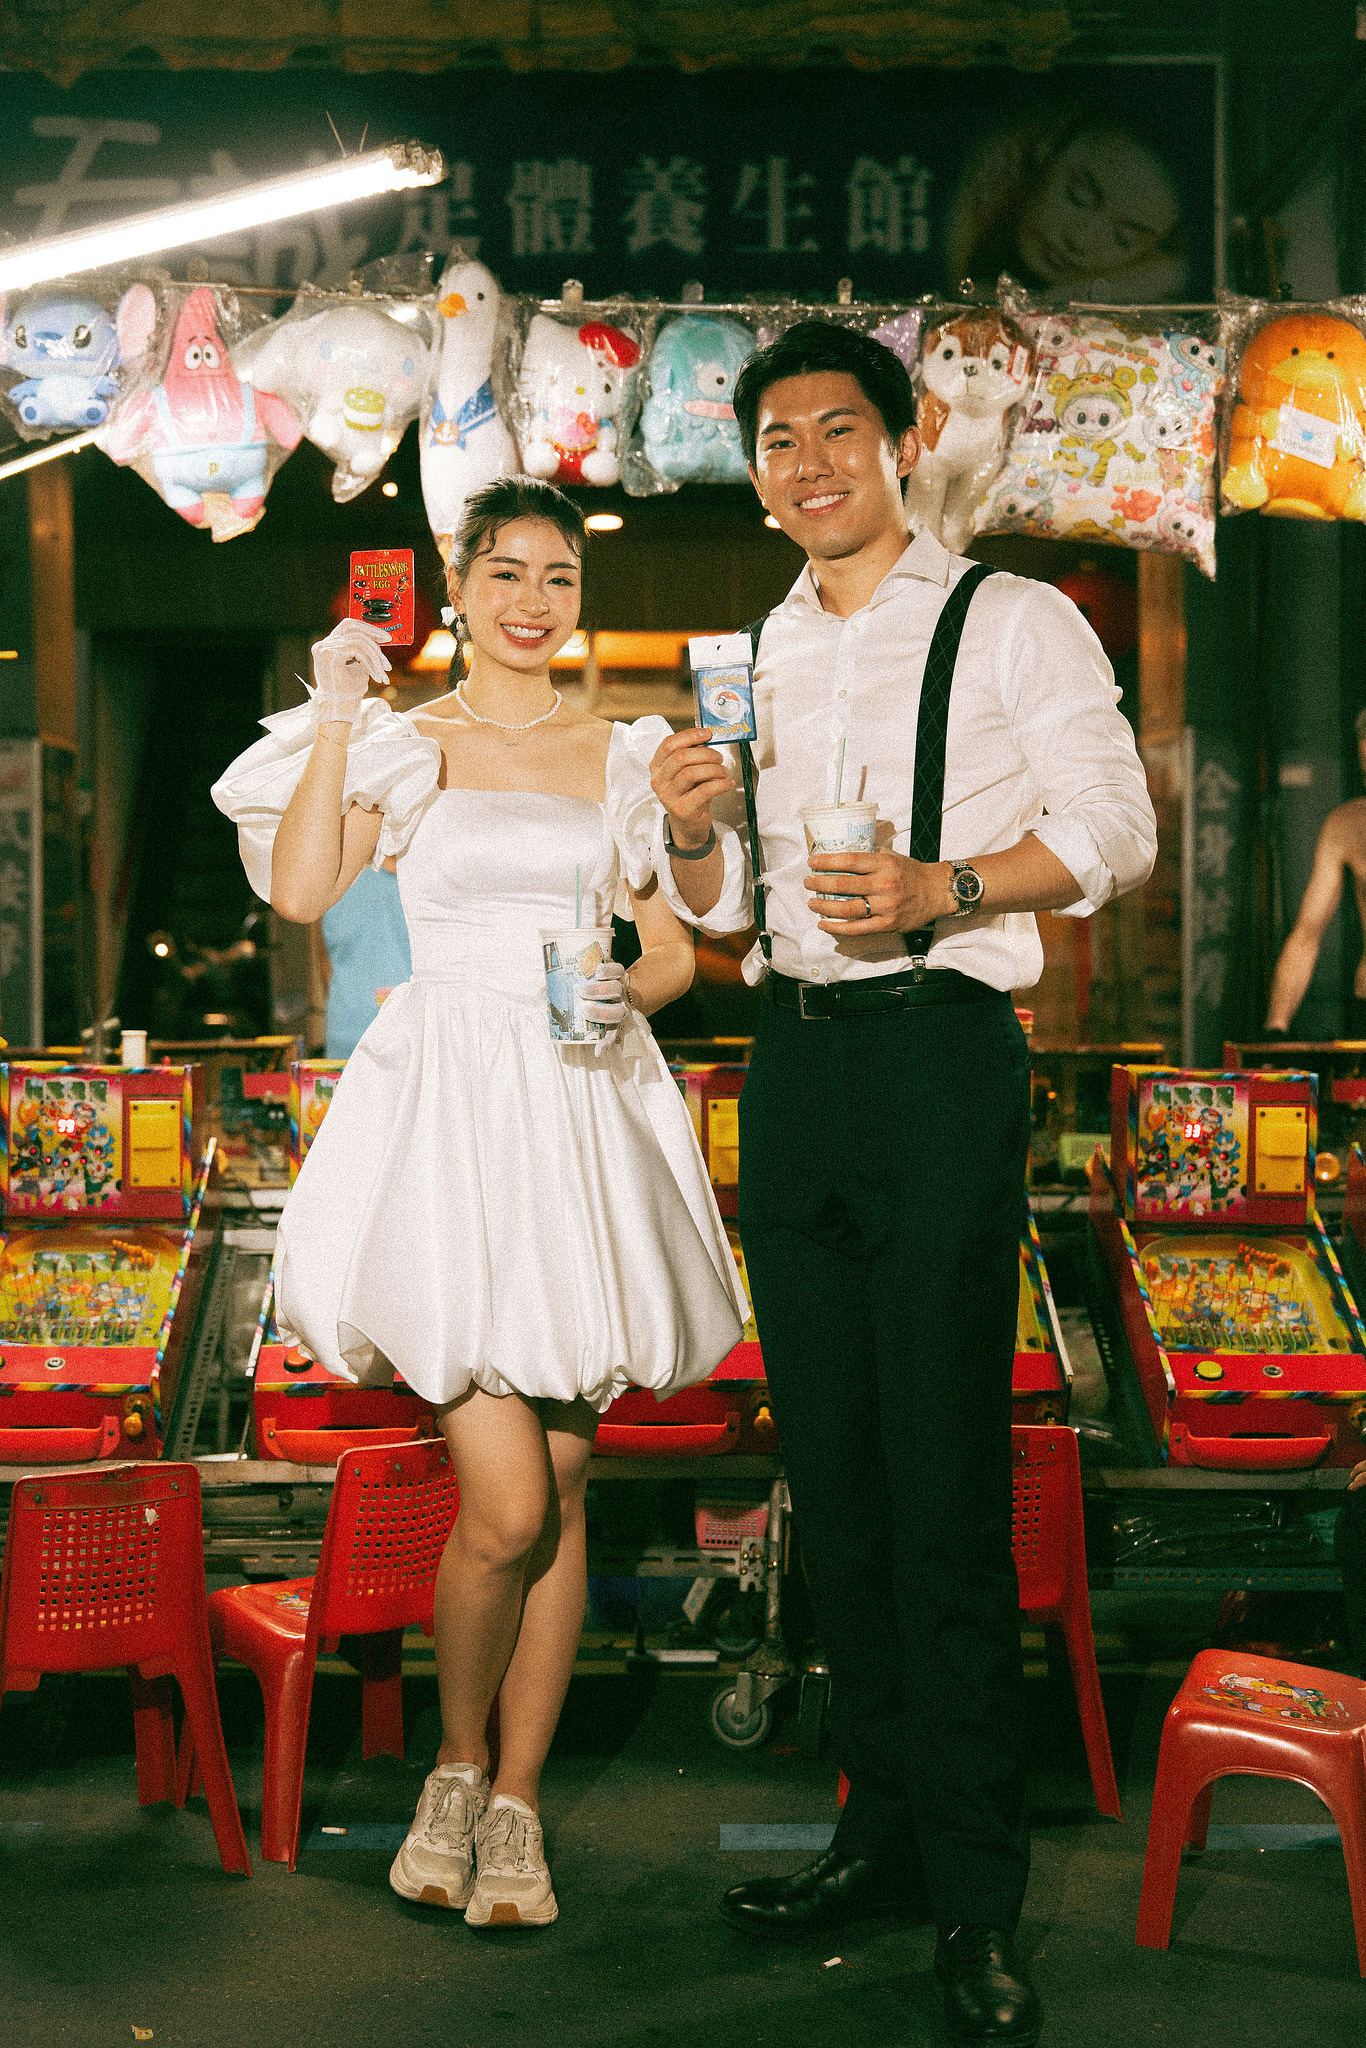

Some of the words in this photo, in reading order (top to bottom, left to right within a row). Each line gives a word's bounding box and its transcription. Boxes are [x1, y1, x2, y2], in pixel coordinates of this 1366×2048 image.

[354, 561, 409, 578] RATTLESNAKE
[373, 580, 391, 589] EGG
[1185, 1123, 1201, 1138] 33
